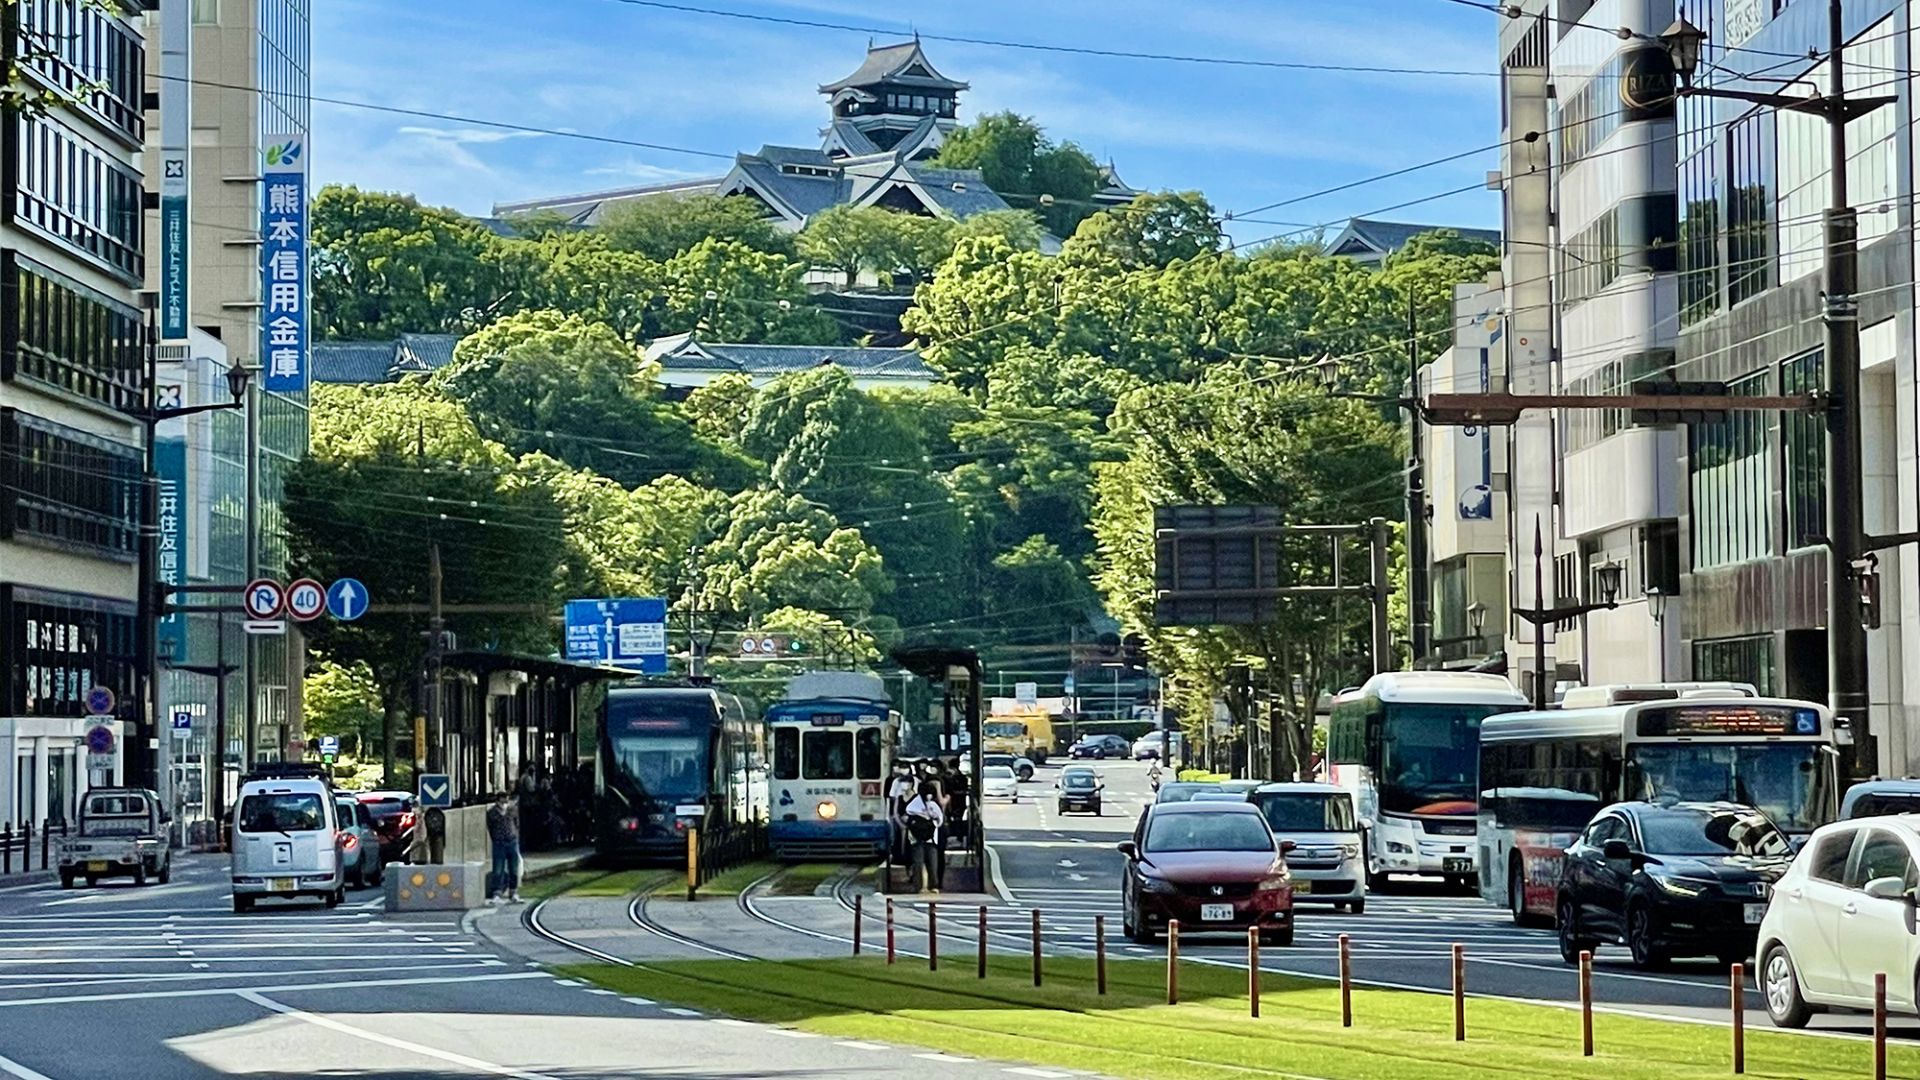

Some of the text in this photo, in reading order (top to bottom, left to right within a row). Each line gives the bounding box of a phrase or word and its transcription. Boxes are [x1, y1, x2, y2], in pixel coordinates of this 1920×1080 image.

[1629, 73, 1674, 91] RIZA
[169, 209, 181, 329] 三井住友トラスト不動産
[268, 183, 300, 378] 熊本信用金庫
[295, 590, 317, 608] 40
